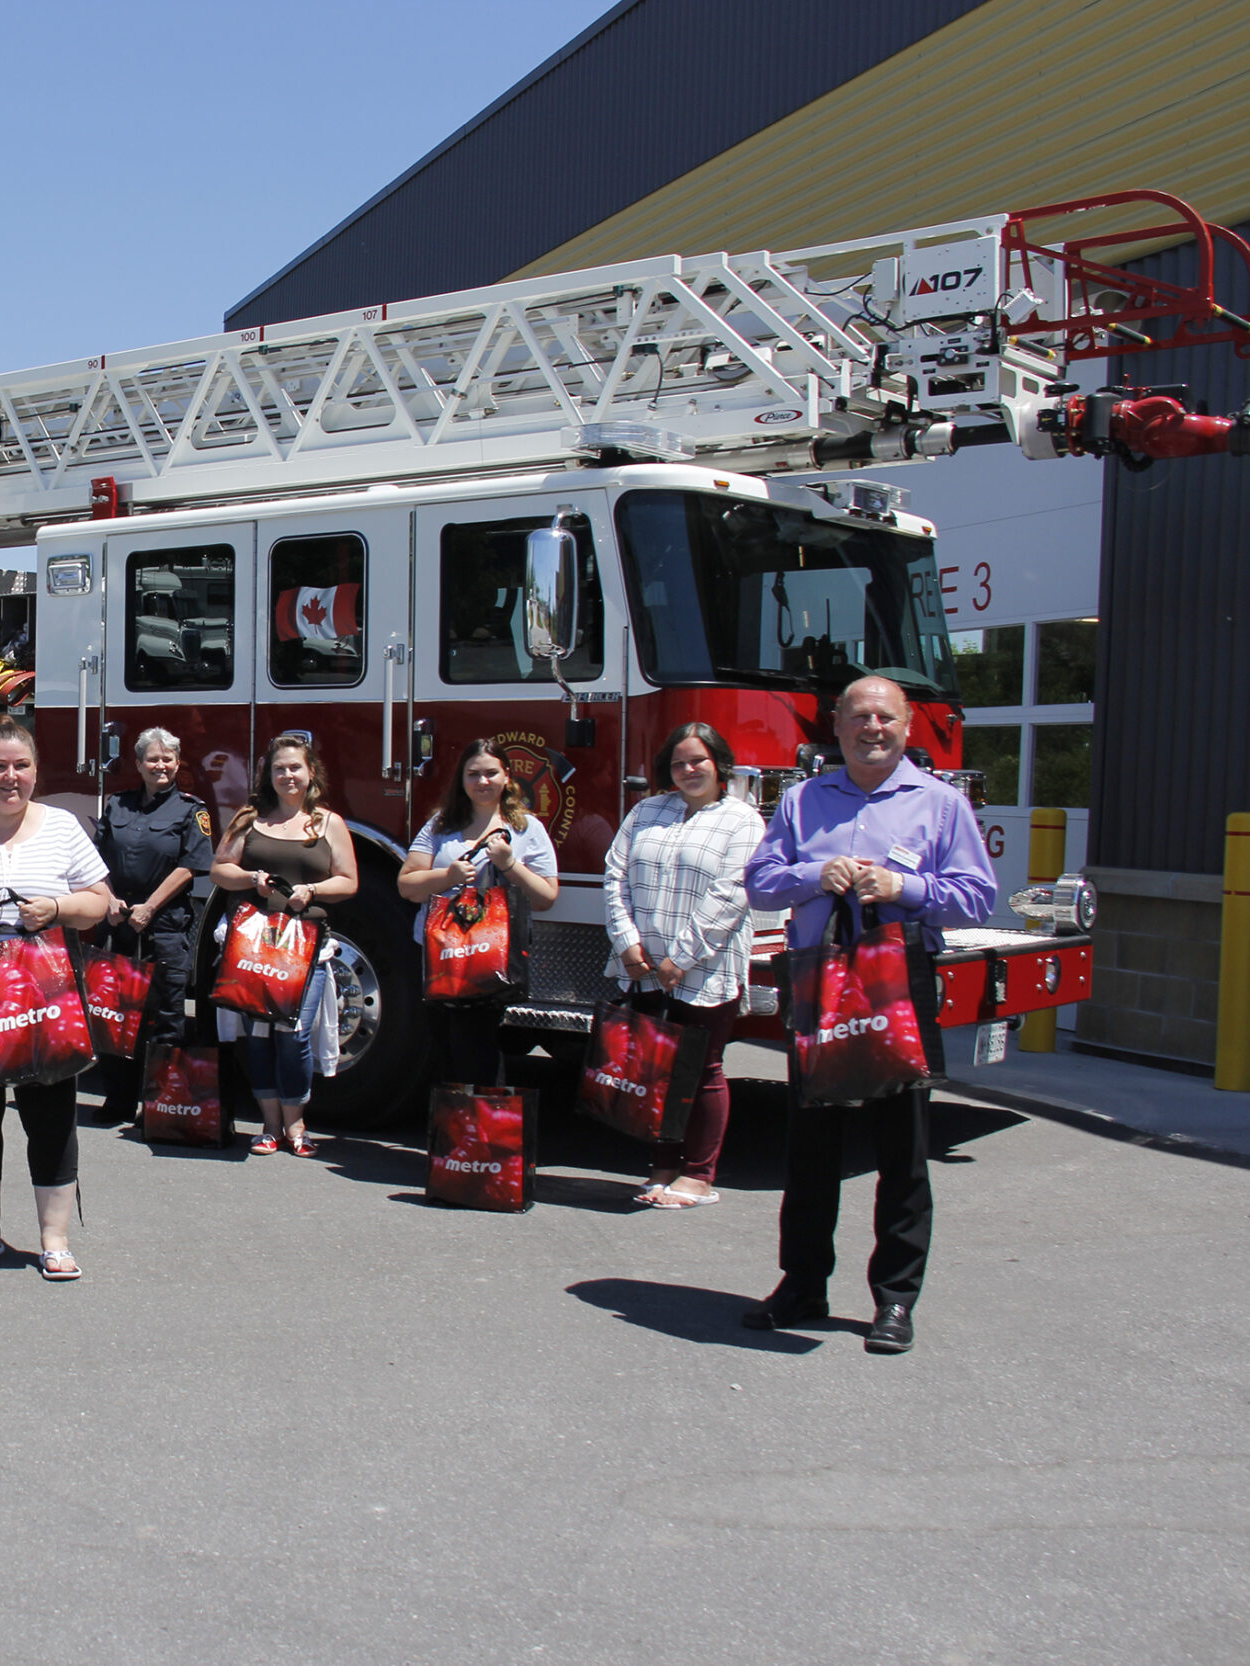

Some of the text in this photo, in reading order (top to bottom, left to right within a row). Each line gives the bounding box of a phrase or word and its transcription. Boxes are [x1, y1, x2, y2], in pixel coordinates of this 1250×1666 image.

[928, 266, 984, 292] 107
[361, 309, 378, 321] 107
[240, 331, 256, 342] 100
[87, 359, 99, 370] 90
[972, 561, 992, 612] 3
[561, 692, 622, 704] EFORCER
[491, 731, 546, 748] DWARD
[509, 759, 535, 775] IRE
[554, 785, 576, 848] COUNTY
[439, 942, 491, 960] metro
[236, 957, 289, 981] metro
[815, 1014, 889, 1045] metro
[594, 1071, 648, 1097] metro
[156, 1101, 202, 1117] metro
[445, 1158, 503, 1174] metro
